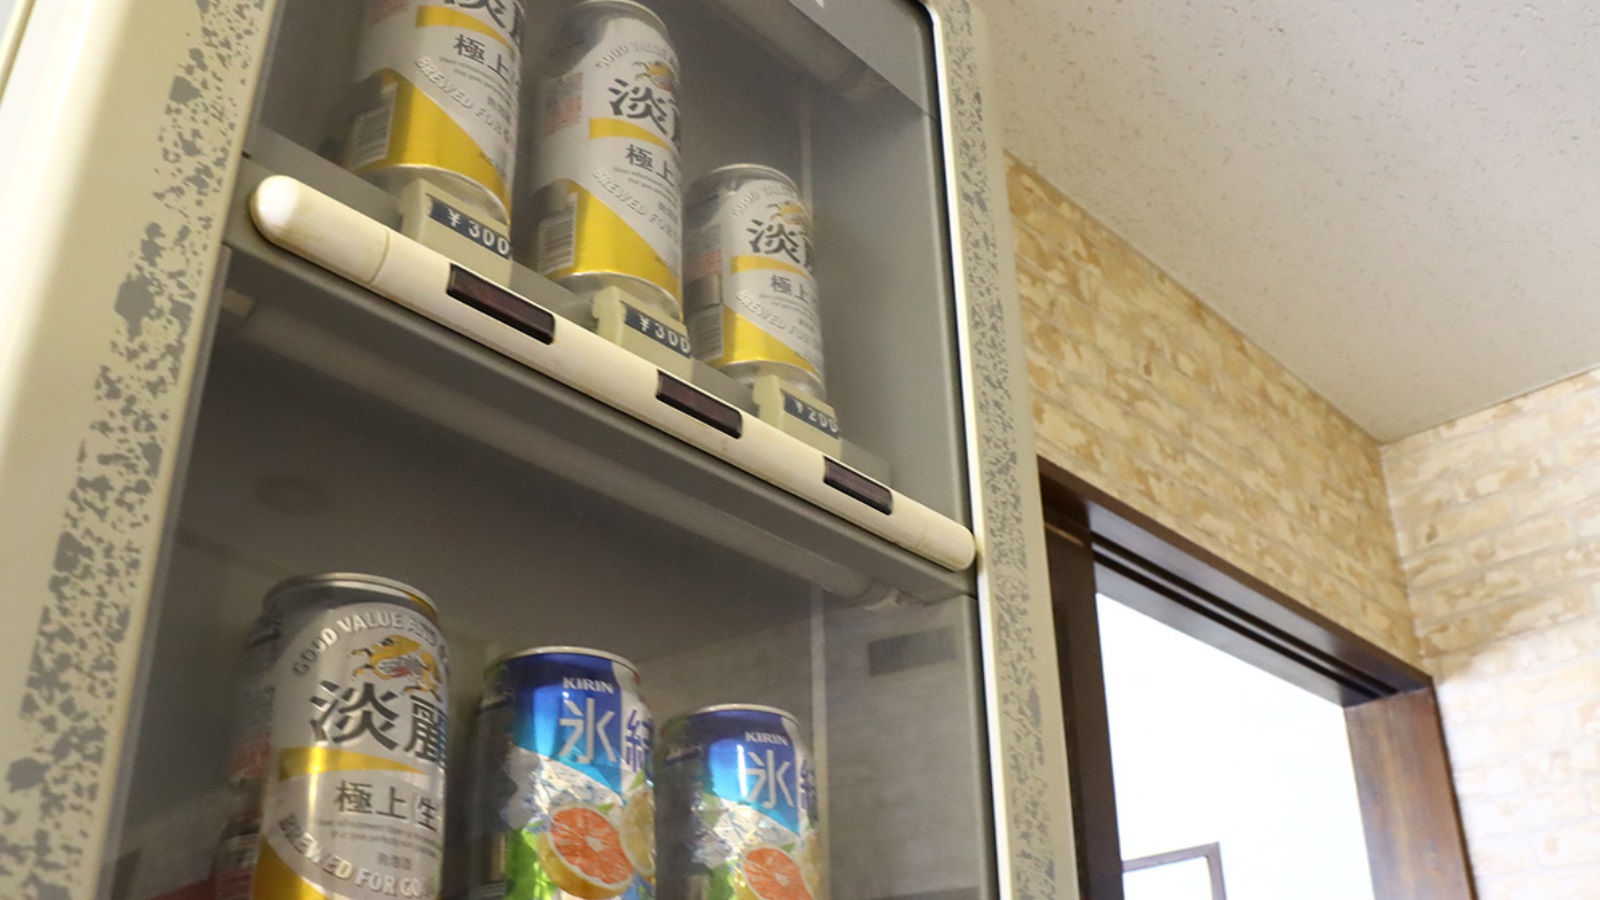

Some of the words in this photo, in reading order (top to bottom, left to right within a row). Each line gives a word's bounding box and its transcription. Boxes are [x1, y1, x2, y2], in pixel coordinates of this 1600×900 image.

[414, 57, 473, 110] BREWED
[292, 626, 341, 678] GOOD
[336, 610, 405, 634] VALUE
[562, 676, 615, 695] KIRIN
[744, 731, 790, 747] KIRIN
[278, 813, 354, 880] BREWED
[354, 868, 398, 898] FOR
